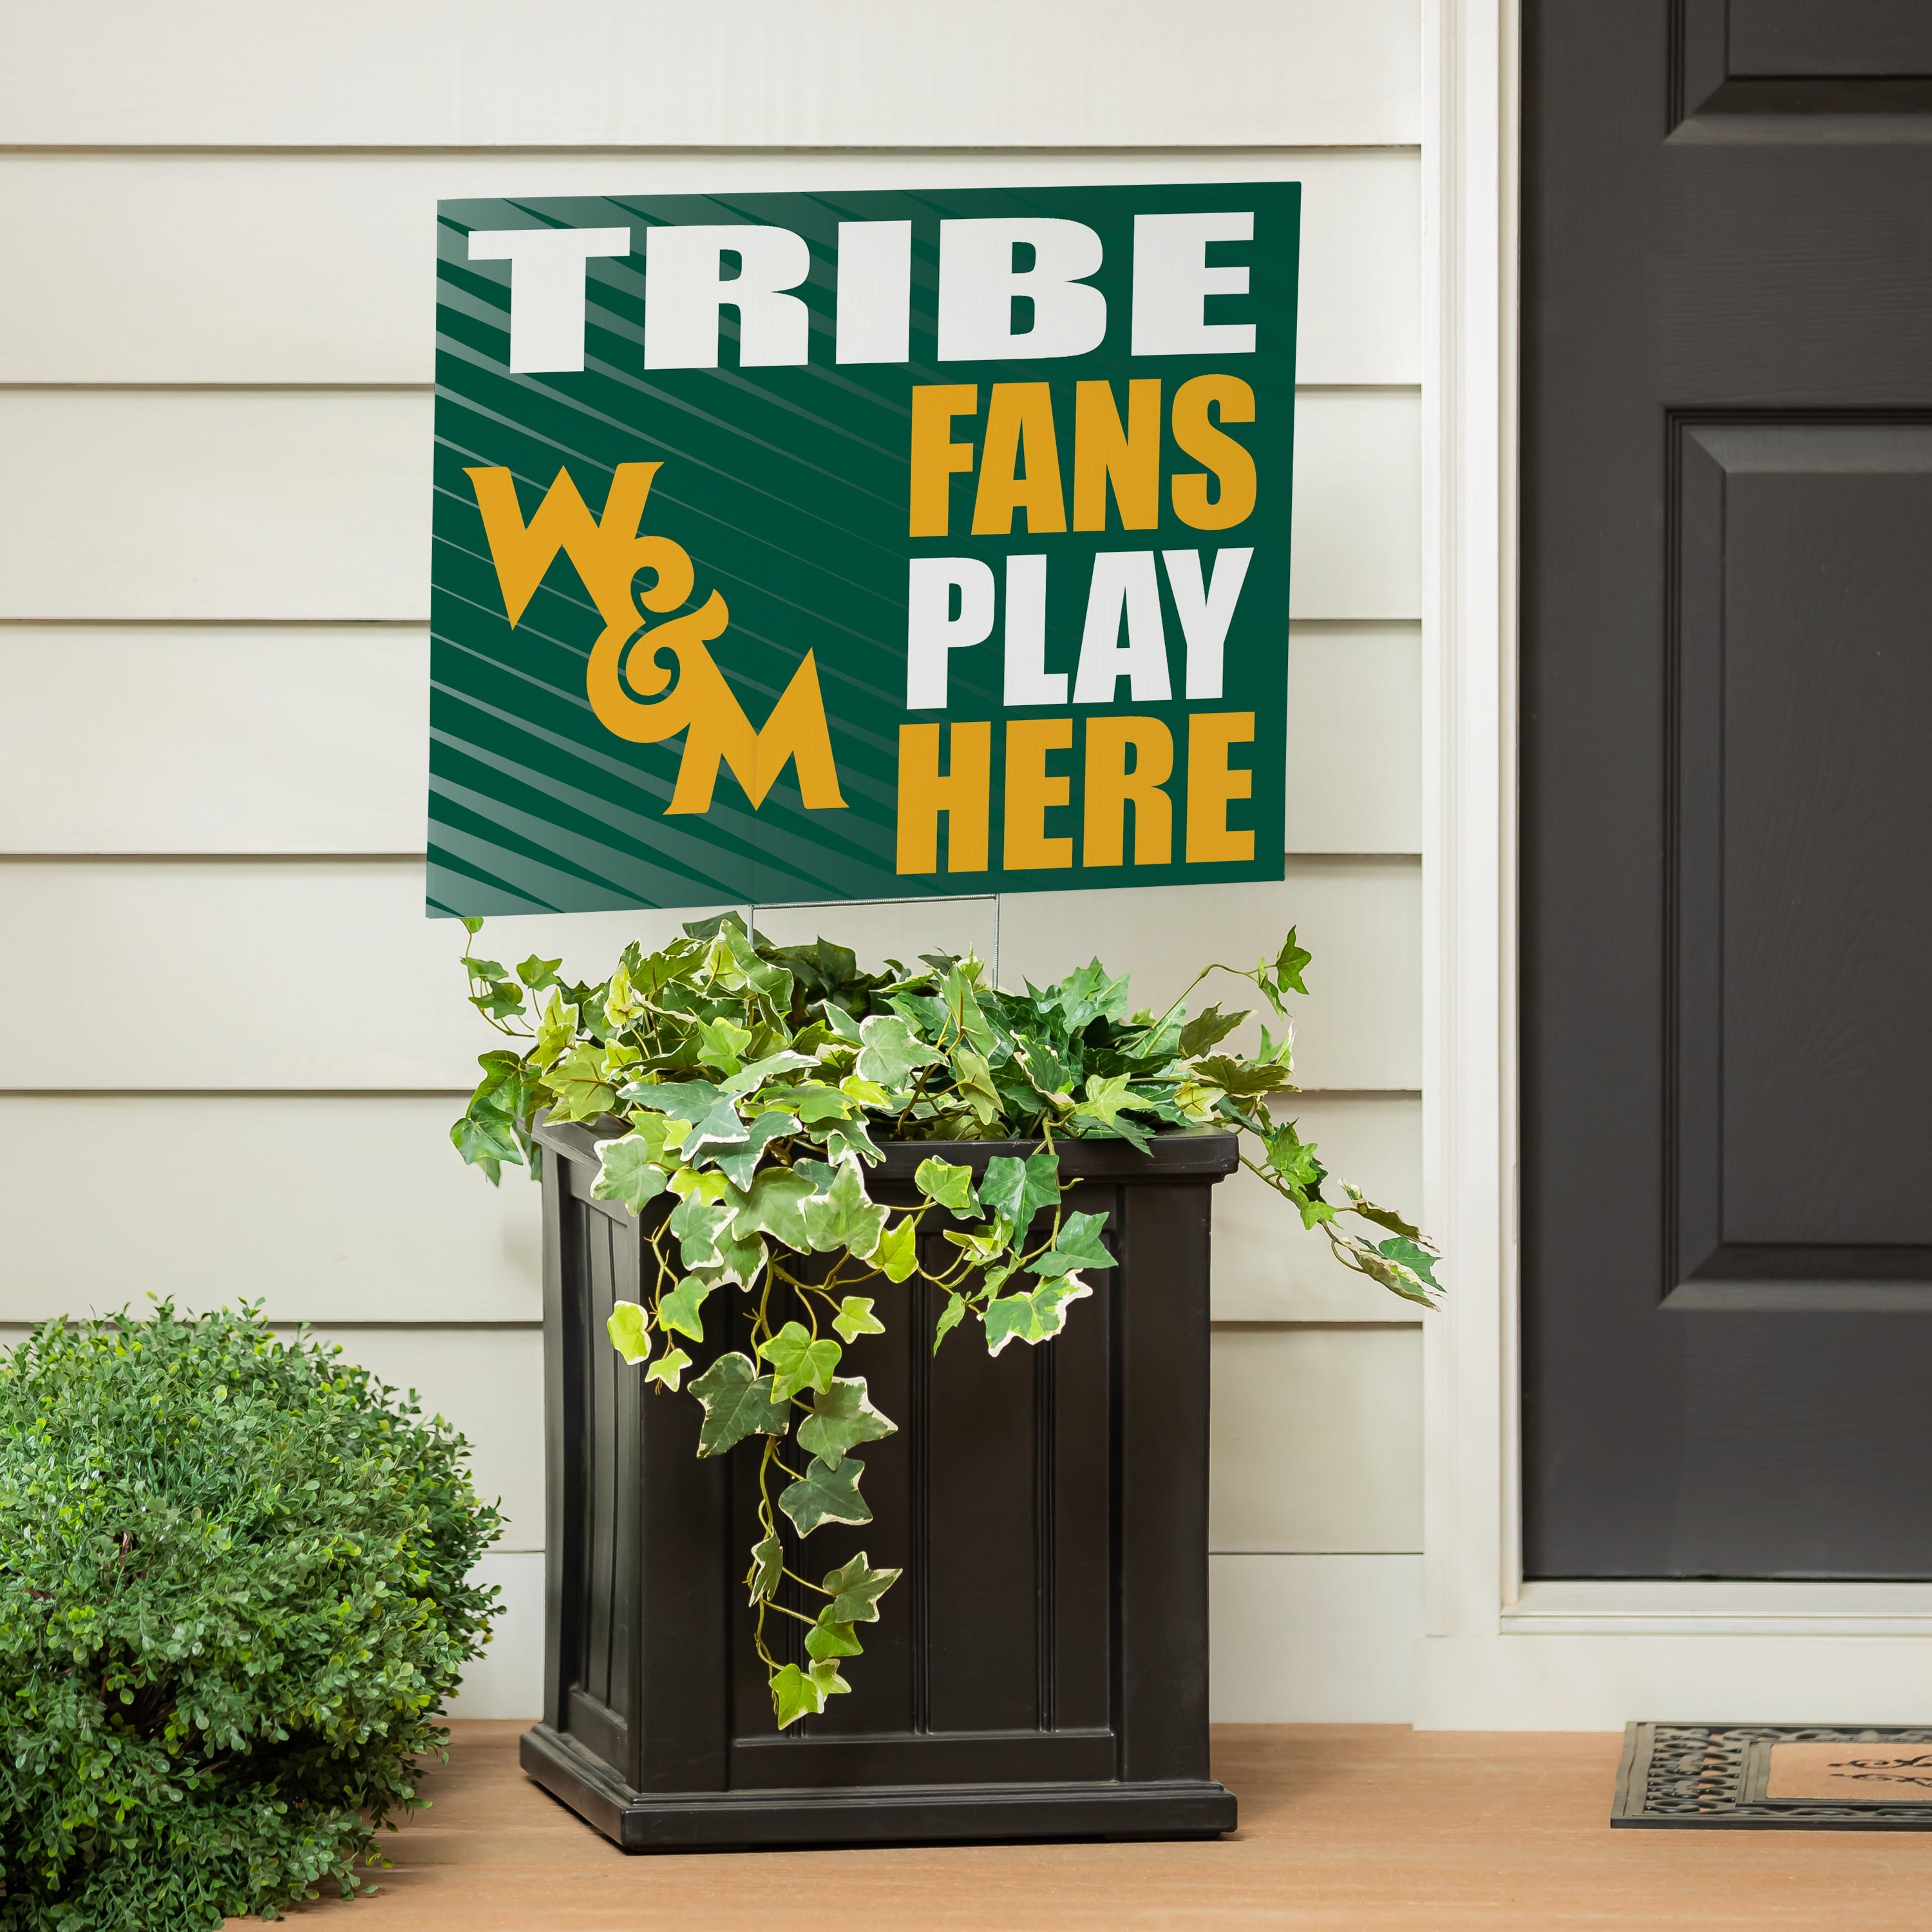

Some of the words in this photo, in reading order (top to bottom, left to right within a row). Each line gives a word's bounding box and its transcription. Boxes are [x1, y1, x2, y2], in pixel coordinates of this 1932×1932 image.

[468, 212, 1256, 374] TRIBE
[909, 374, 1256, 537] FANS
[463, 462, 849, 815] W&M
[906, 547, 1255, 710] PLAY
[896, 712, 1255, 875] HERE
